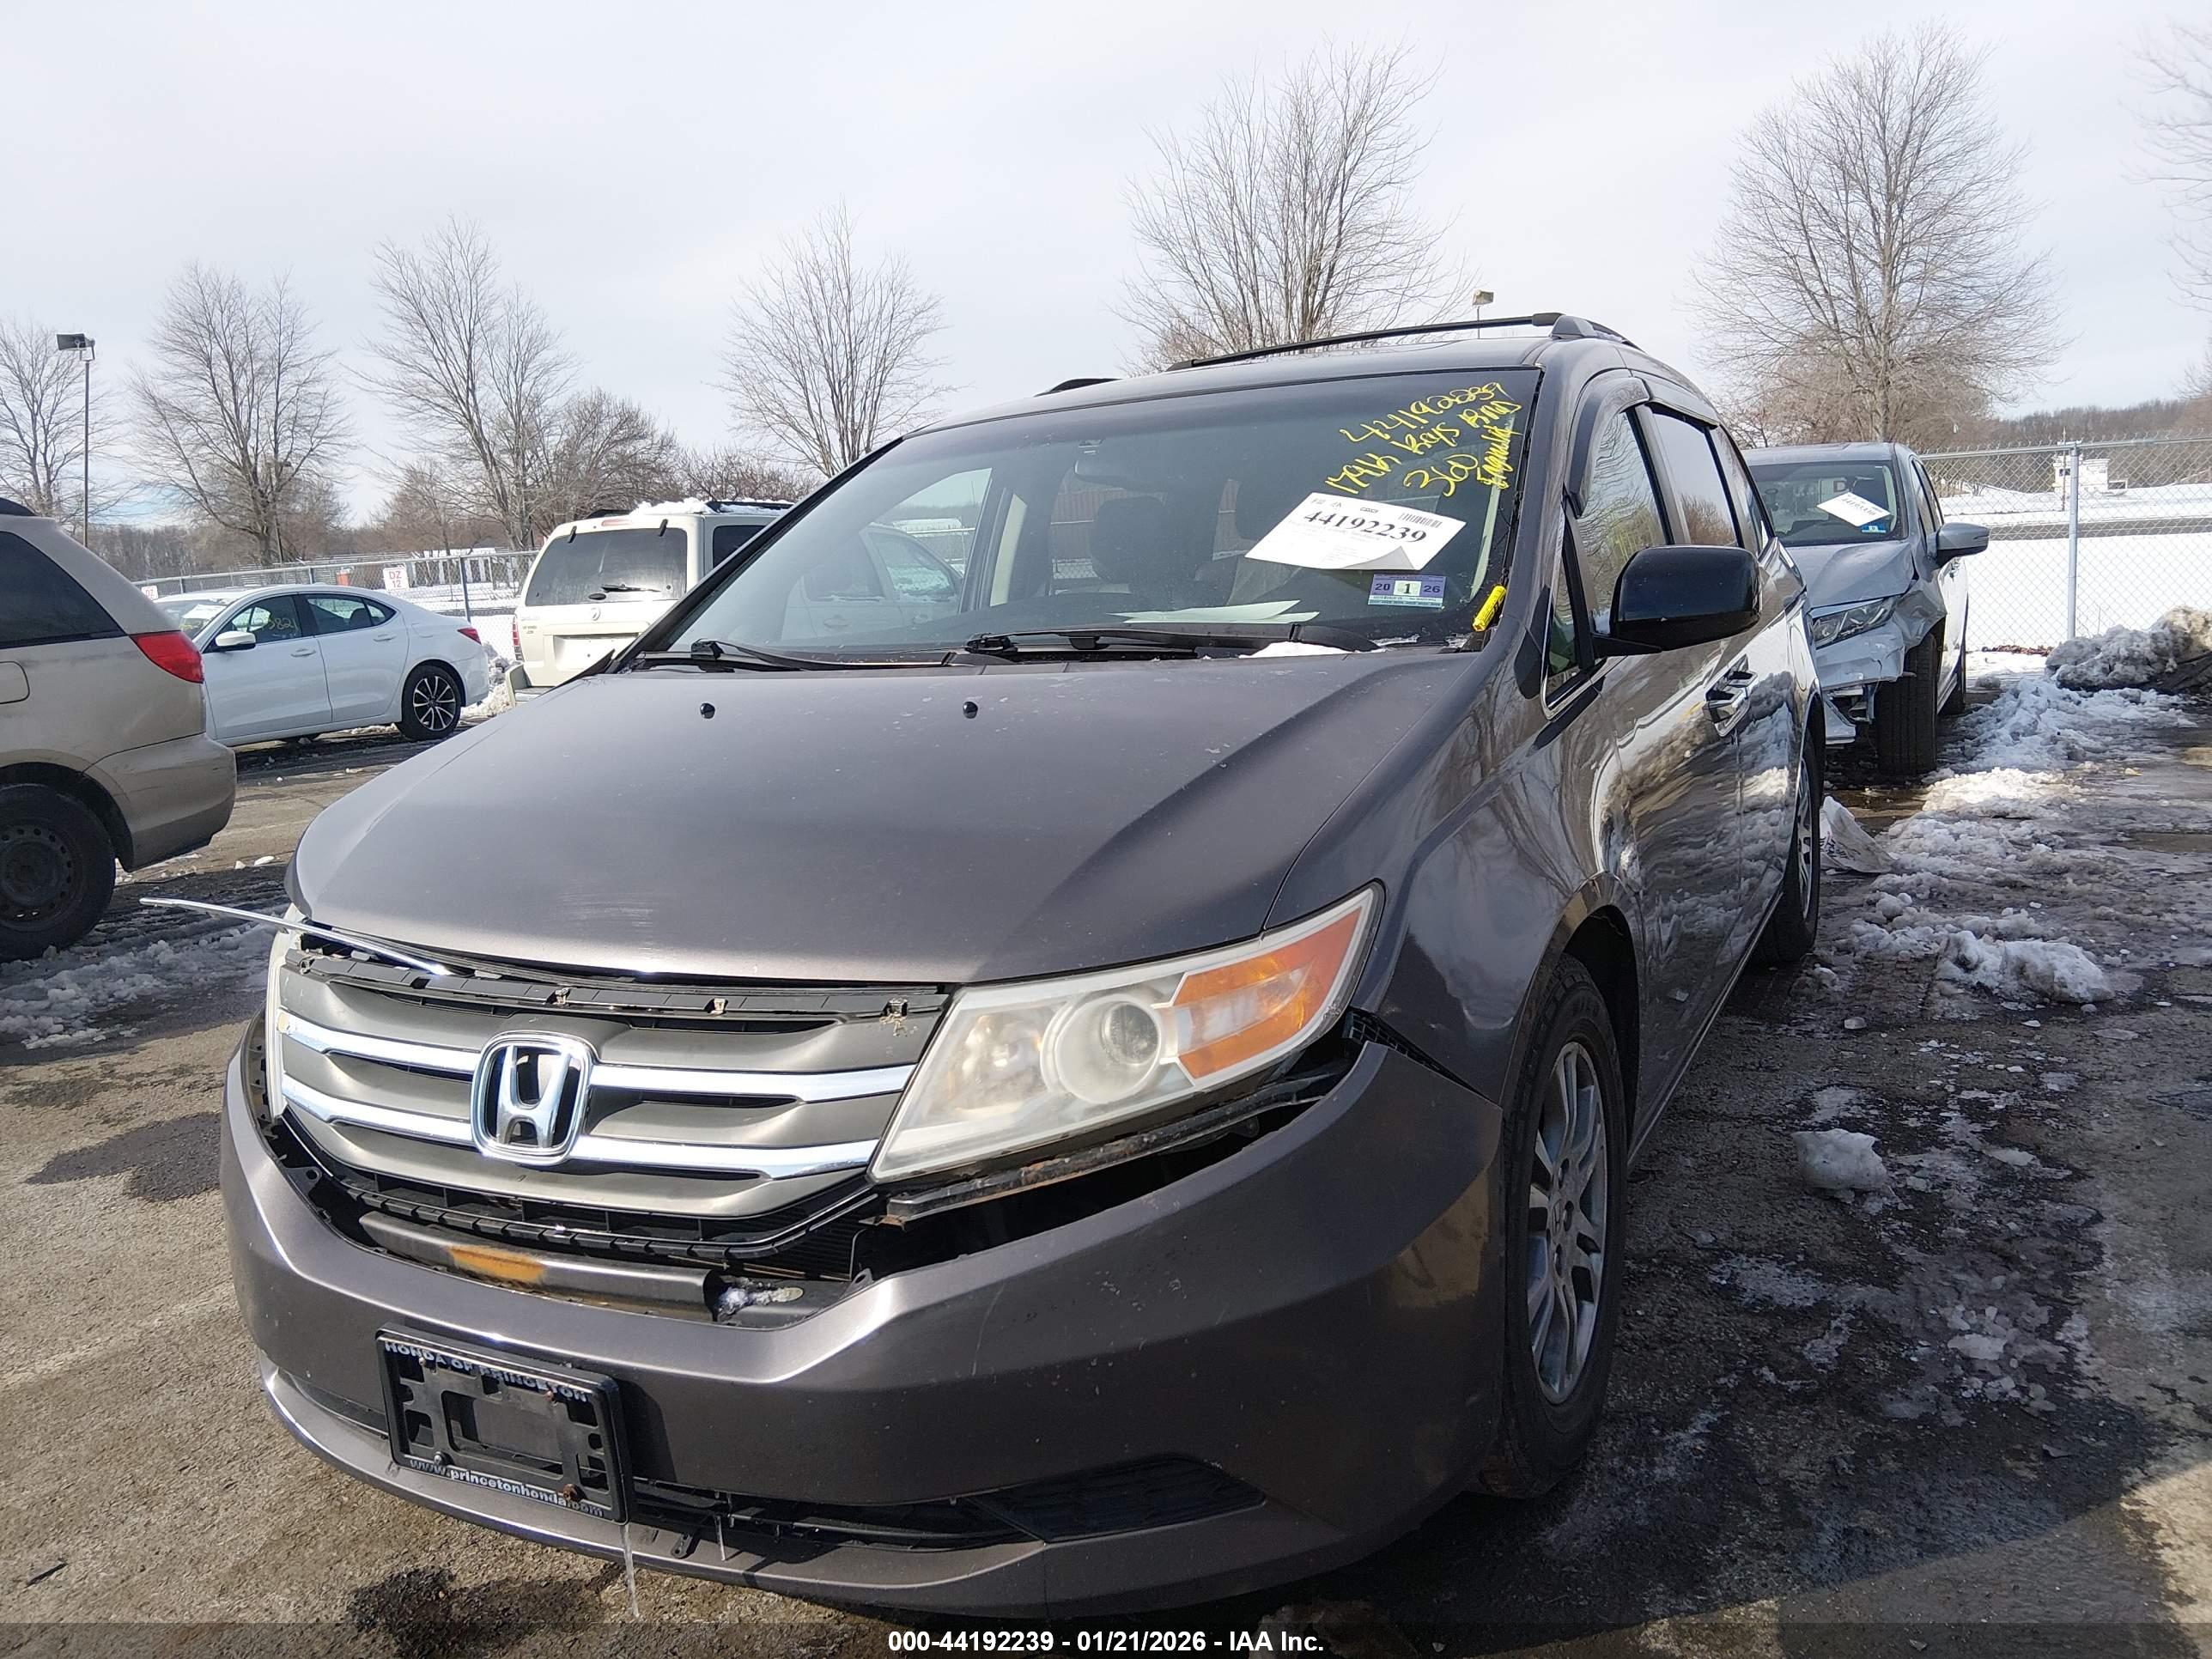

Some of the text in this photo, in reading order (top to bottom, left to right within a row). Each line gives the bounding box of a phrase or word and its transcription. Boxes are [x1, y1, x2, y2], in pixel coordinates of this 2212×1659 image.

[1304, 510, 1427, 543] 44192239
[389, 570, 402, 580] DZ
[392, 580, 402, 588] 12
[1375, 583, 1441, 594] 20 1 26
[384, 1340, 447, 1365] HONDA
